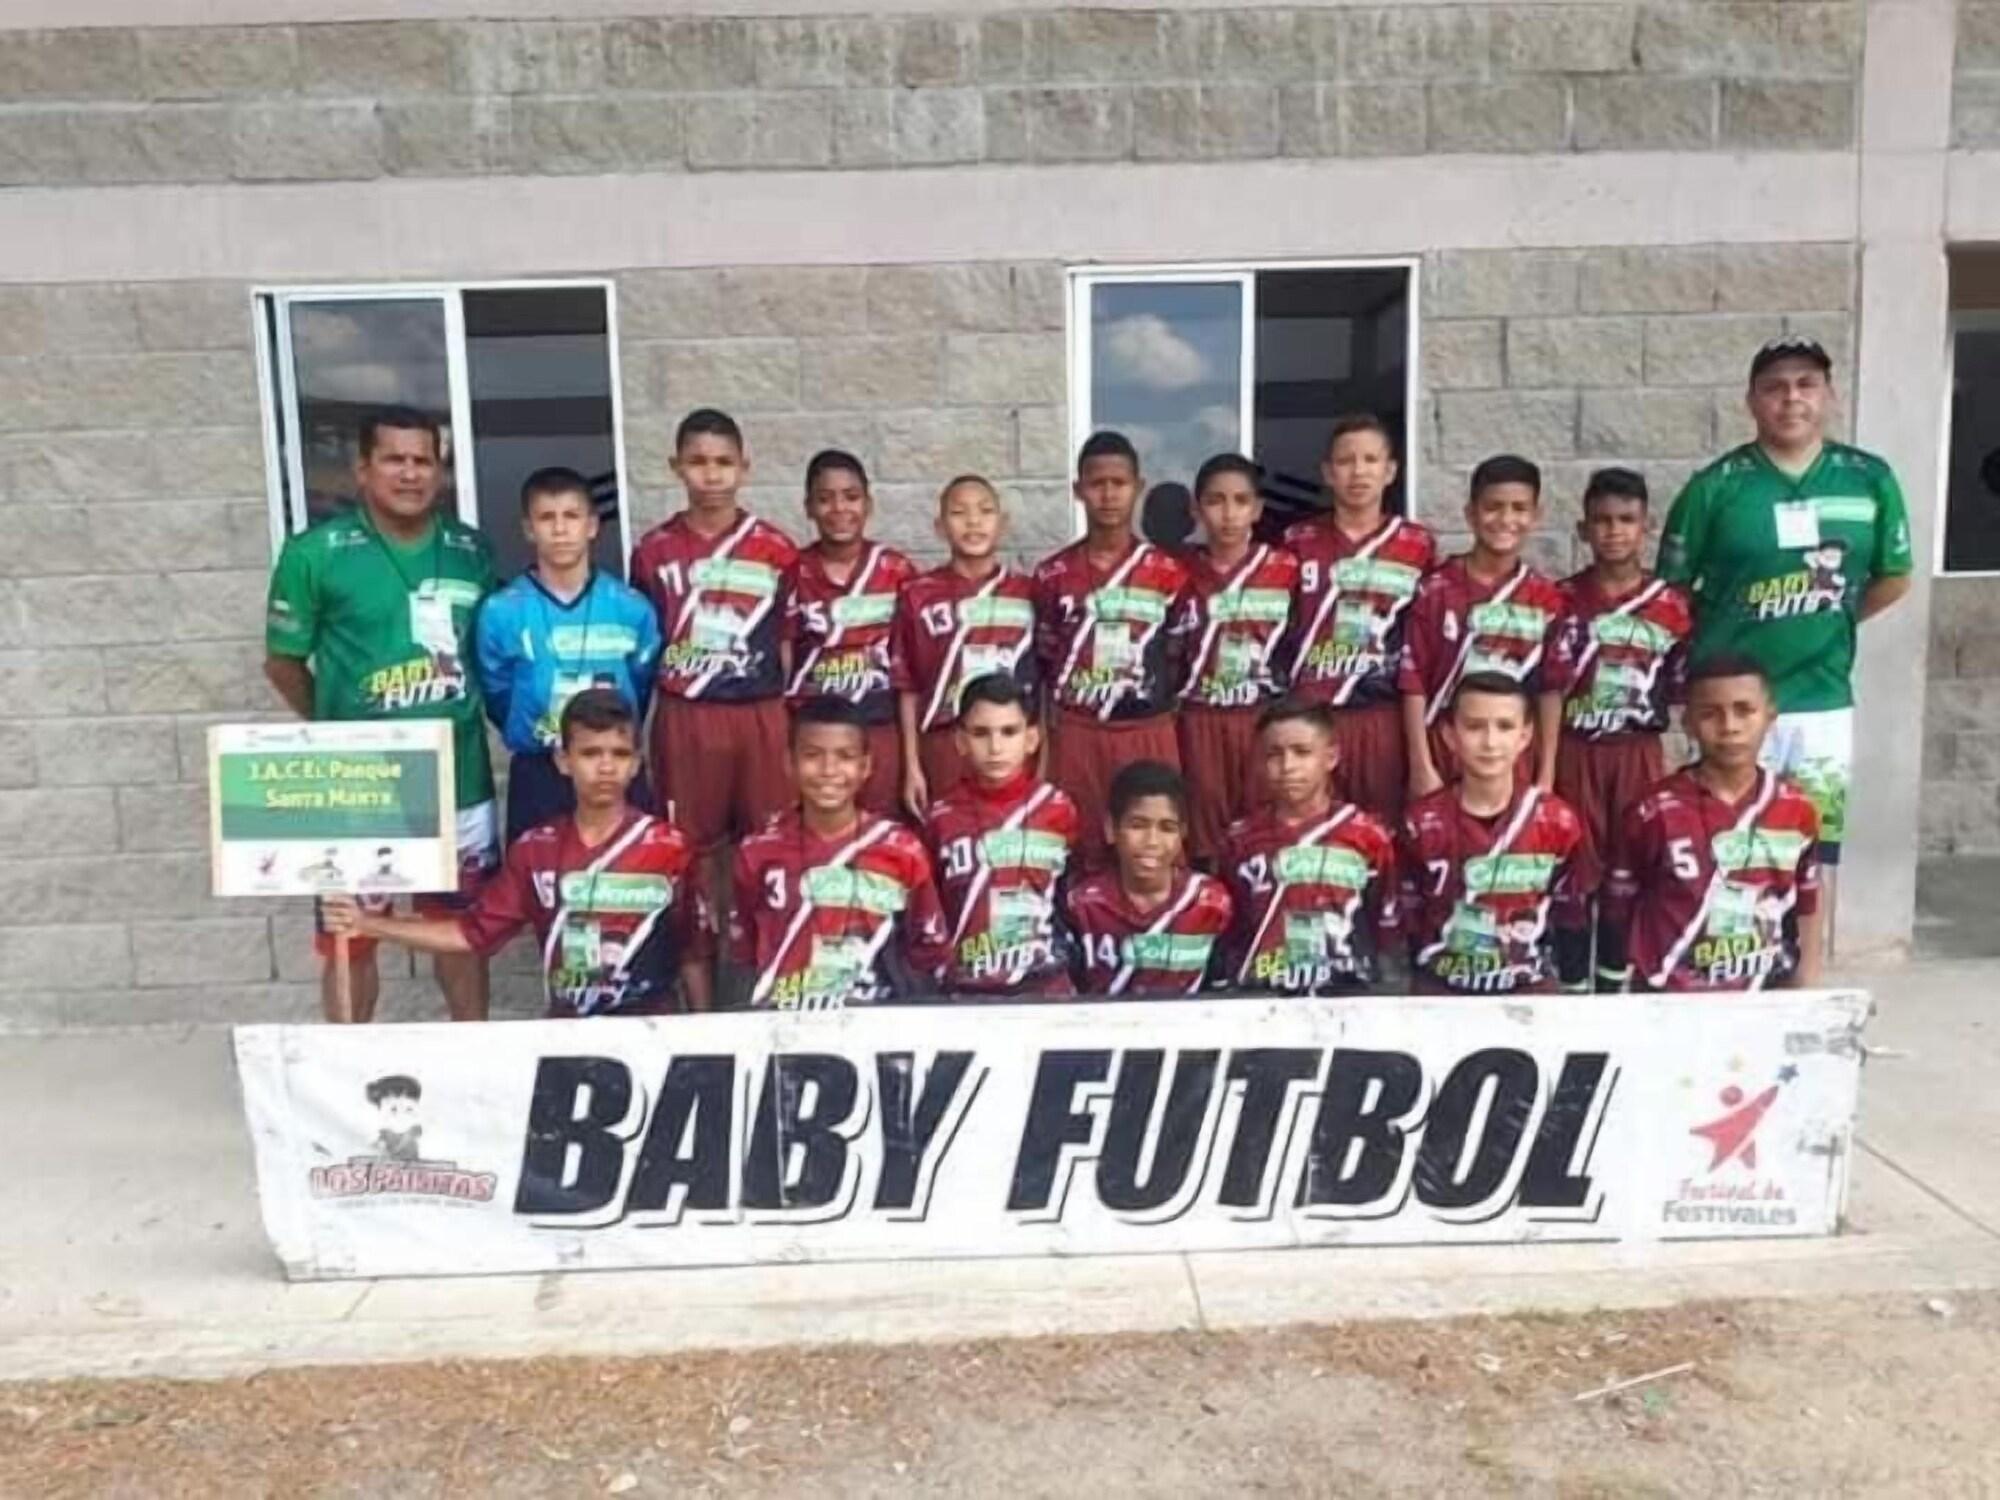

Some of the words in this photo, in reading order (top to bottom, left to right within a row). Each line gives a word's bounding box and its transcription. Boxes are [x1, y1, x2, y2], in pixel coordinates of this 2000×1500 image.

[1302, 560, 1319, 593] 9
[921, 602, 954, 637] 13
[1669, 837, 1700, 879] 5
[764, 867, 787, 910] 3
[1424, 859, 1449, 896] 7
[1082, 932, 1119, 969] 14
[512, 1050, 983, 1228] BABY
[1005, 1047, 1623, 1225] FUTBOL
